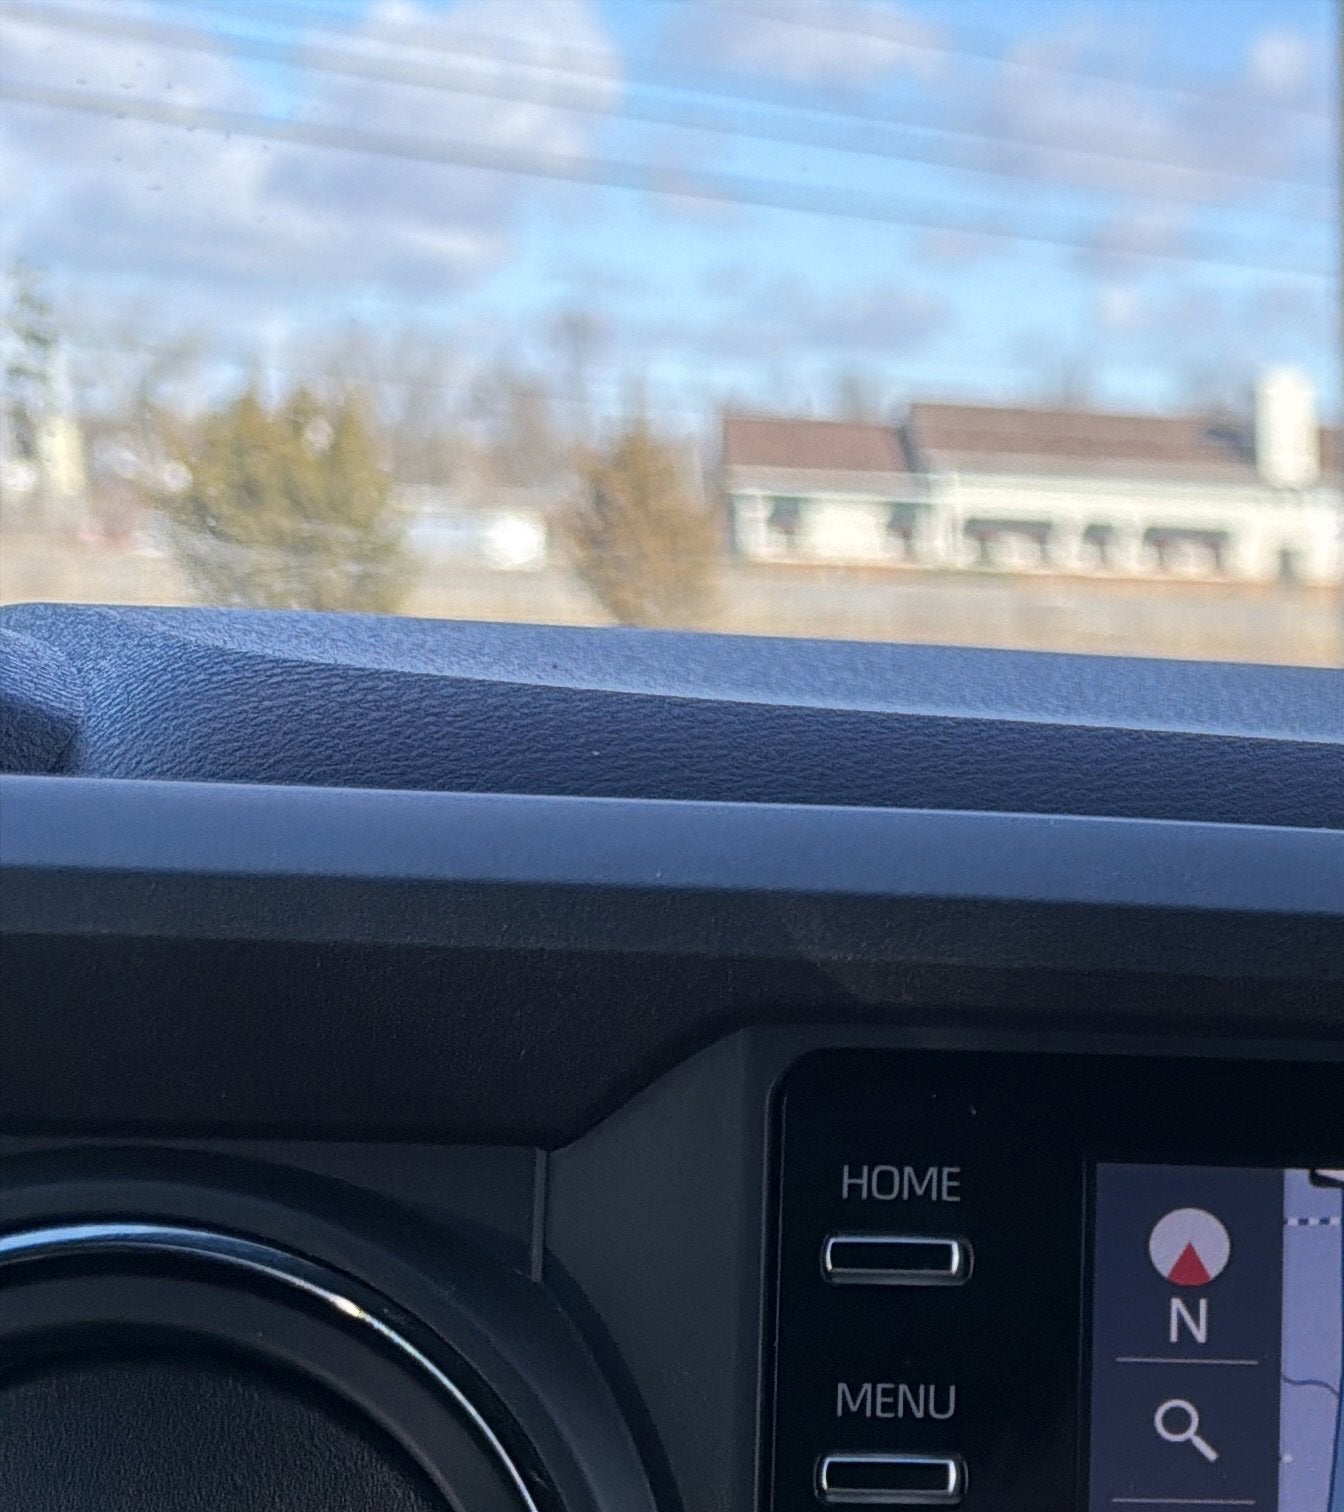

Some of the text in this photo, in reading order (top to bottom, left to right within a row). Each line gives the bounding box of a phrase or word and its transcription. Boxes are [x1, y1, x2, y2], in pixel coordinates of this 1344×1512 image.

[841, 1165, 961, 1201] HOME
[1169, 1297, 1208, 1344] N
[836, 1382, 956, 1419] MENU
